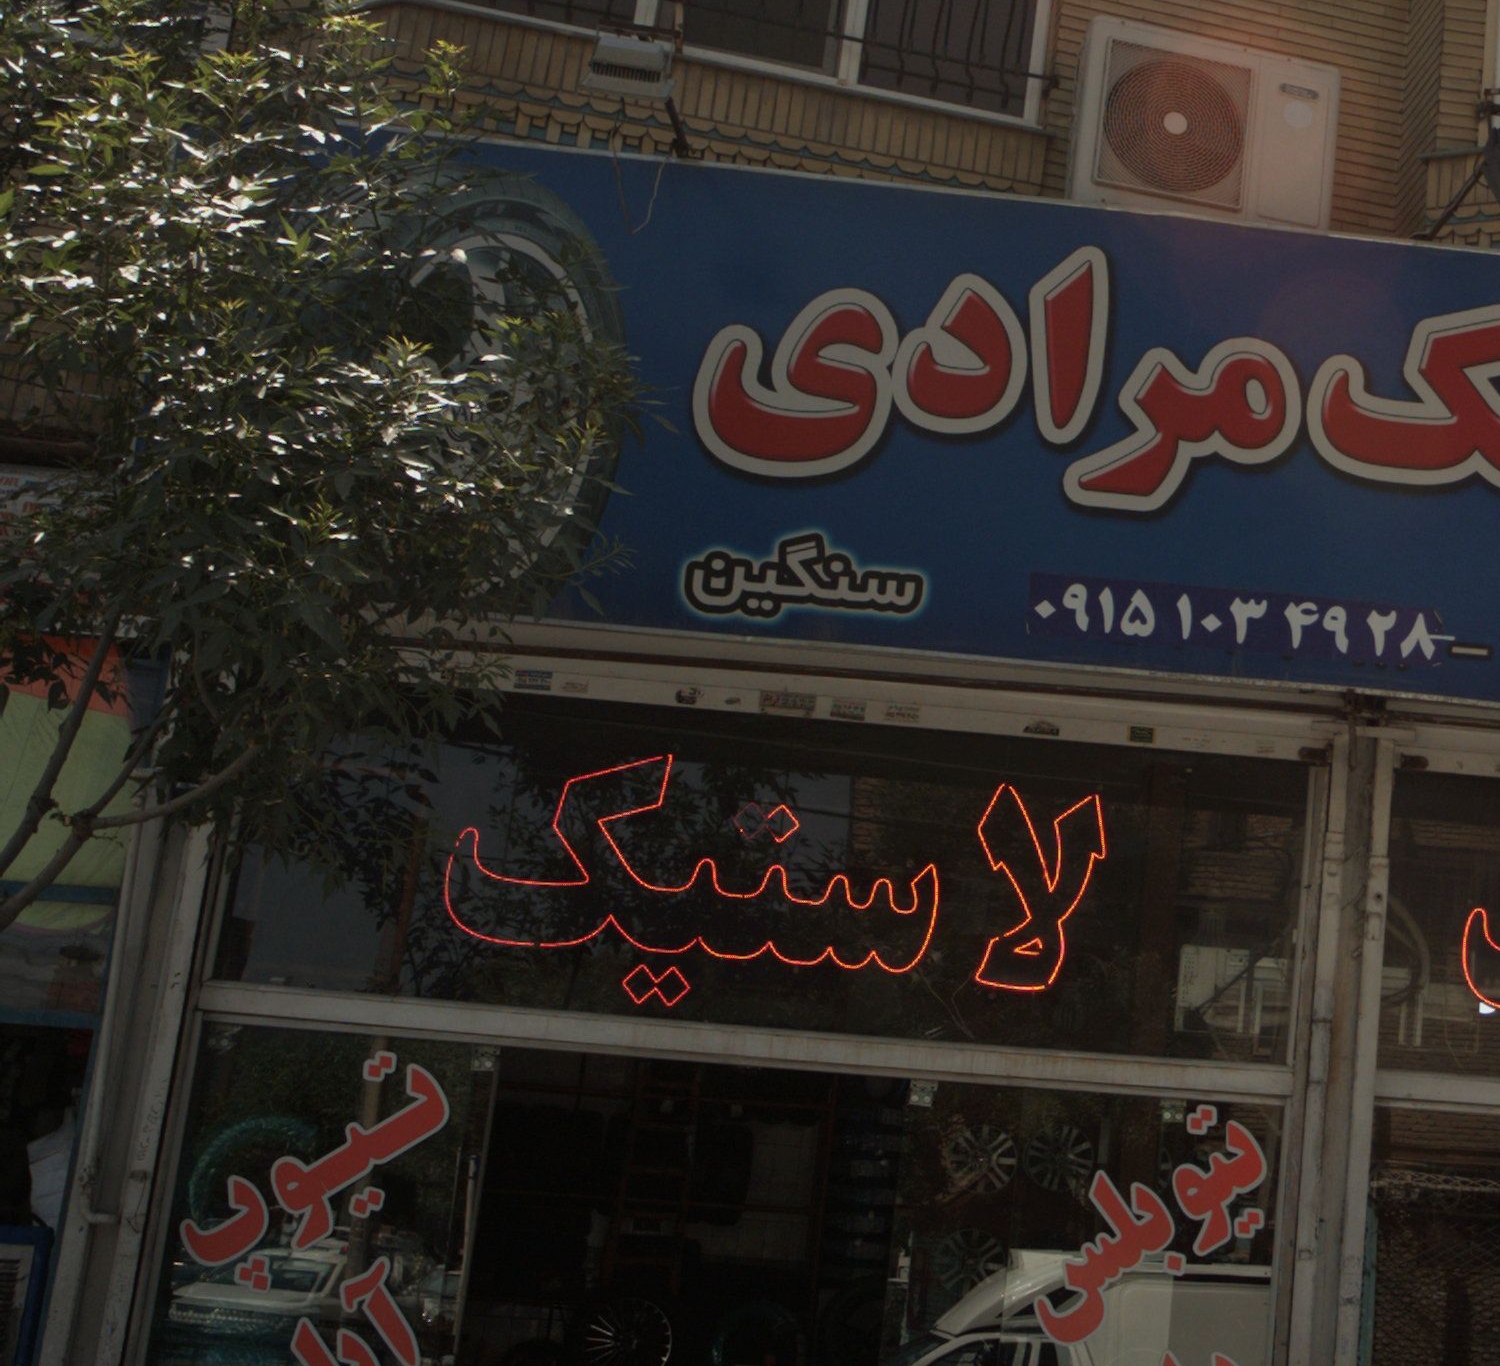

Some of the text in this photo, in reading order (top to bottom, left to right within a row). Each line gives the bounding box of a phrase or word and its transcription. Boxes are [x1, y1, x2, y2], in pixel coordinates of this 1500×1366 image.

[692, 245, 1302, 512] مرادی
[684, 534, 923, 618] سنگین
[444, 753, 1106, 1007] لاستیک
[179, 1050, 450, 1292] تیوپ
[1034, 1103, 1267, 1344] تیوبلس
